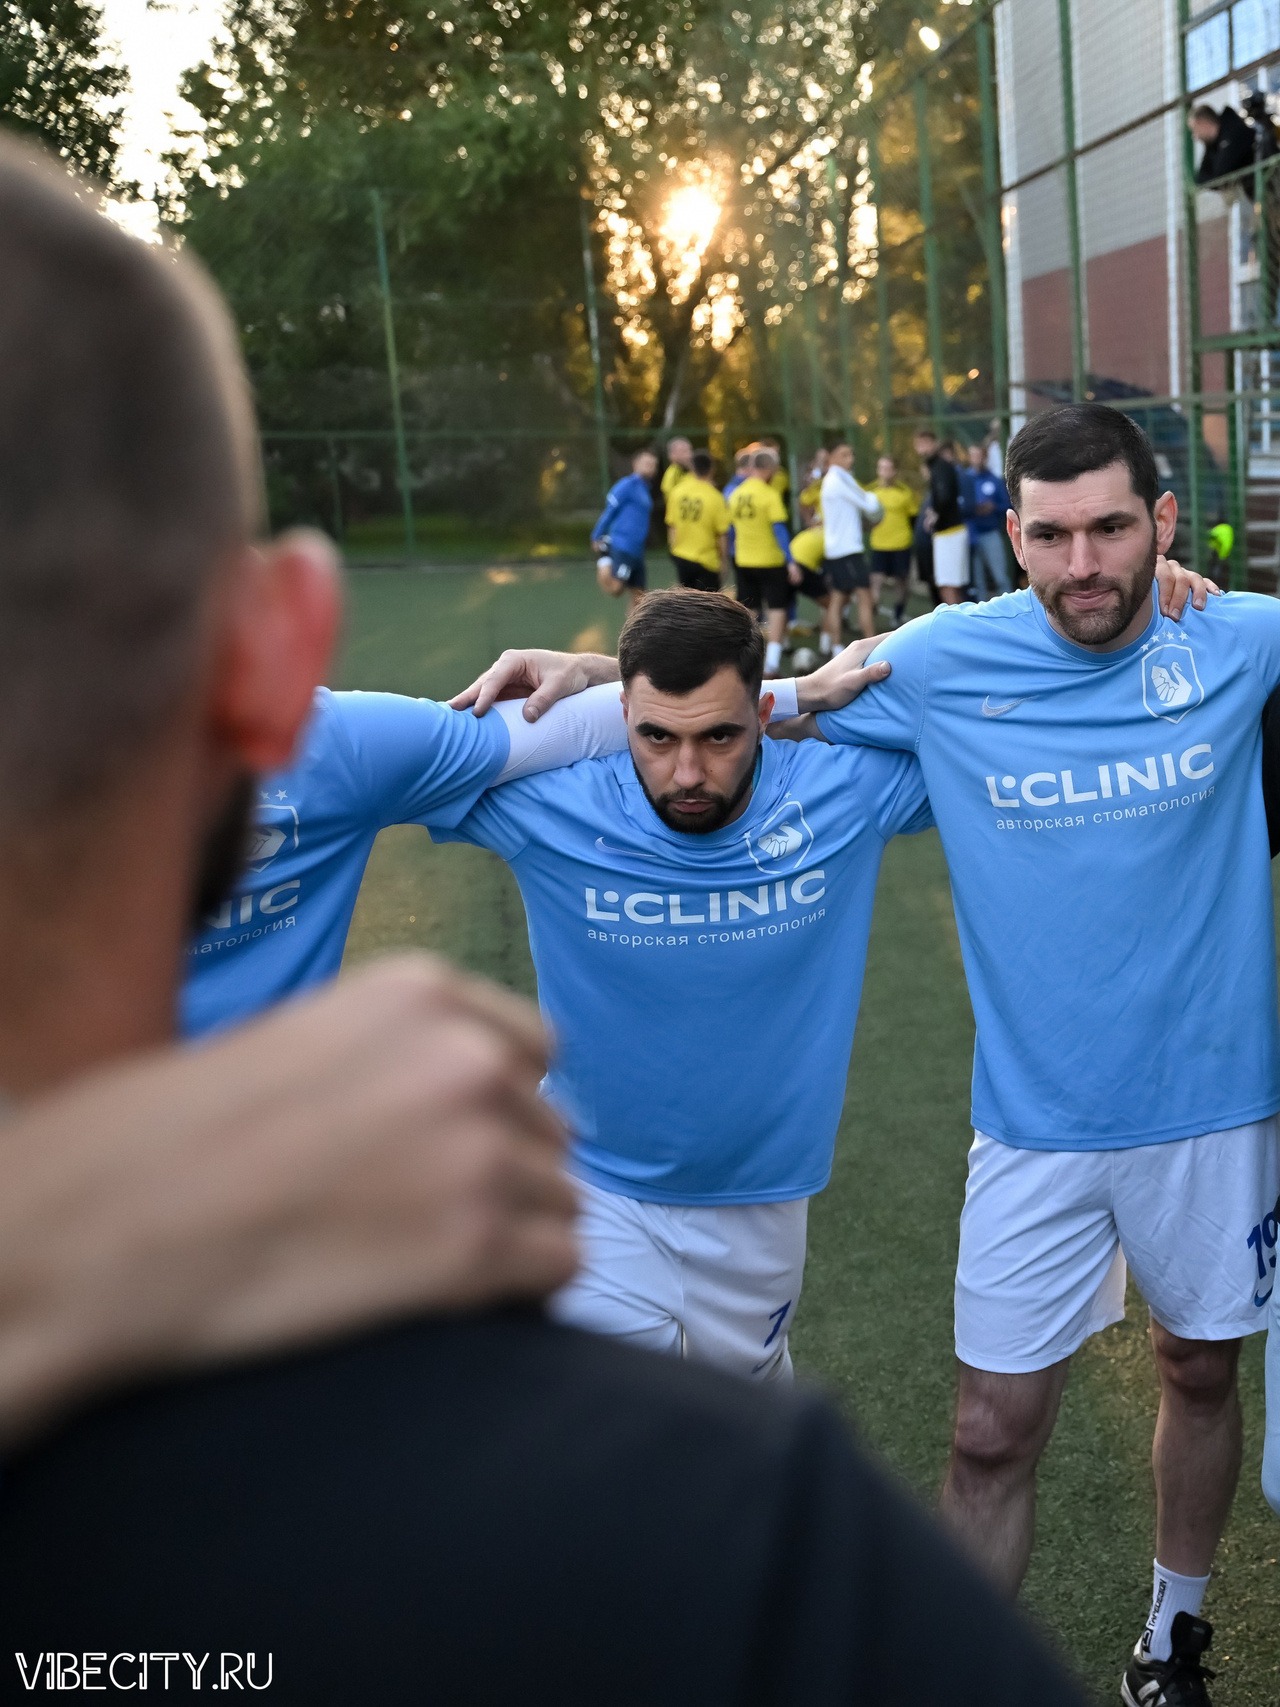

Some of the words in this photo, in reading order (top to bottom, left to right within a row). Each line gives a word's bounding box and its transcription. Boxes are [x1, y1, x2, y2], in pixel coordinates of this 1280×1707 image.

[996, 813, 1085, 832] авторская
[1093, 785, 1216, 825] стоматология
[587, 929, 689, 948] авторская
[697, 908, 826, 945] стоматология
